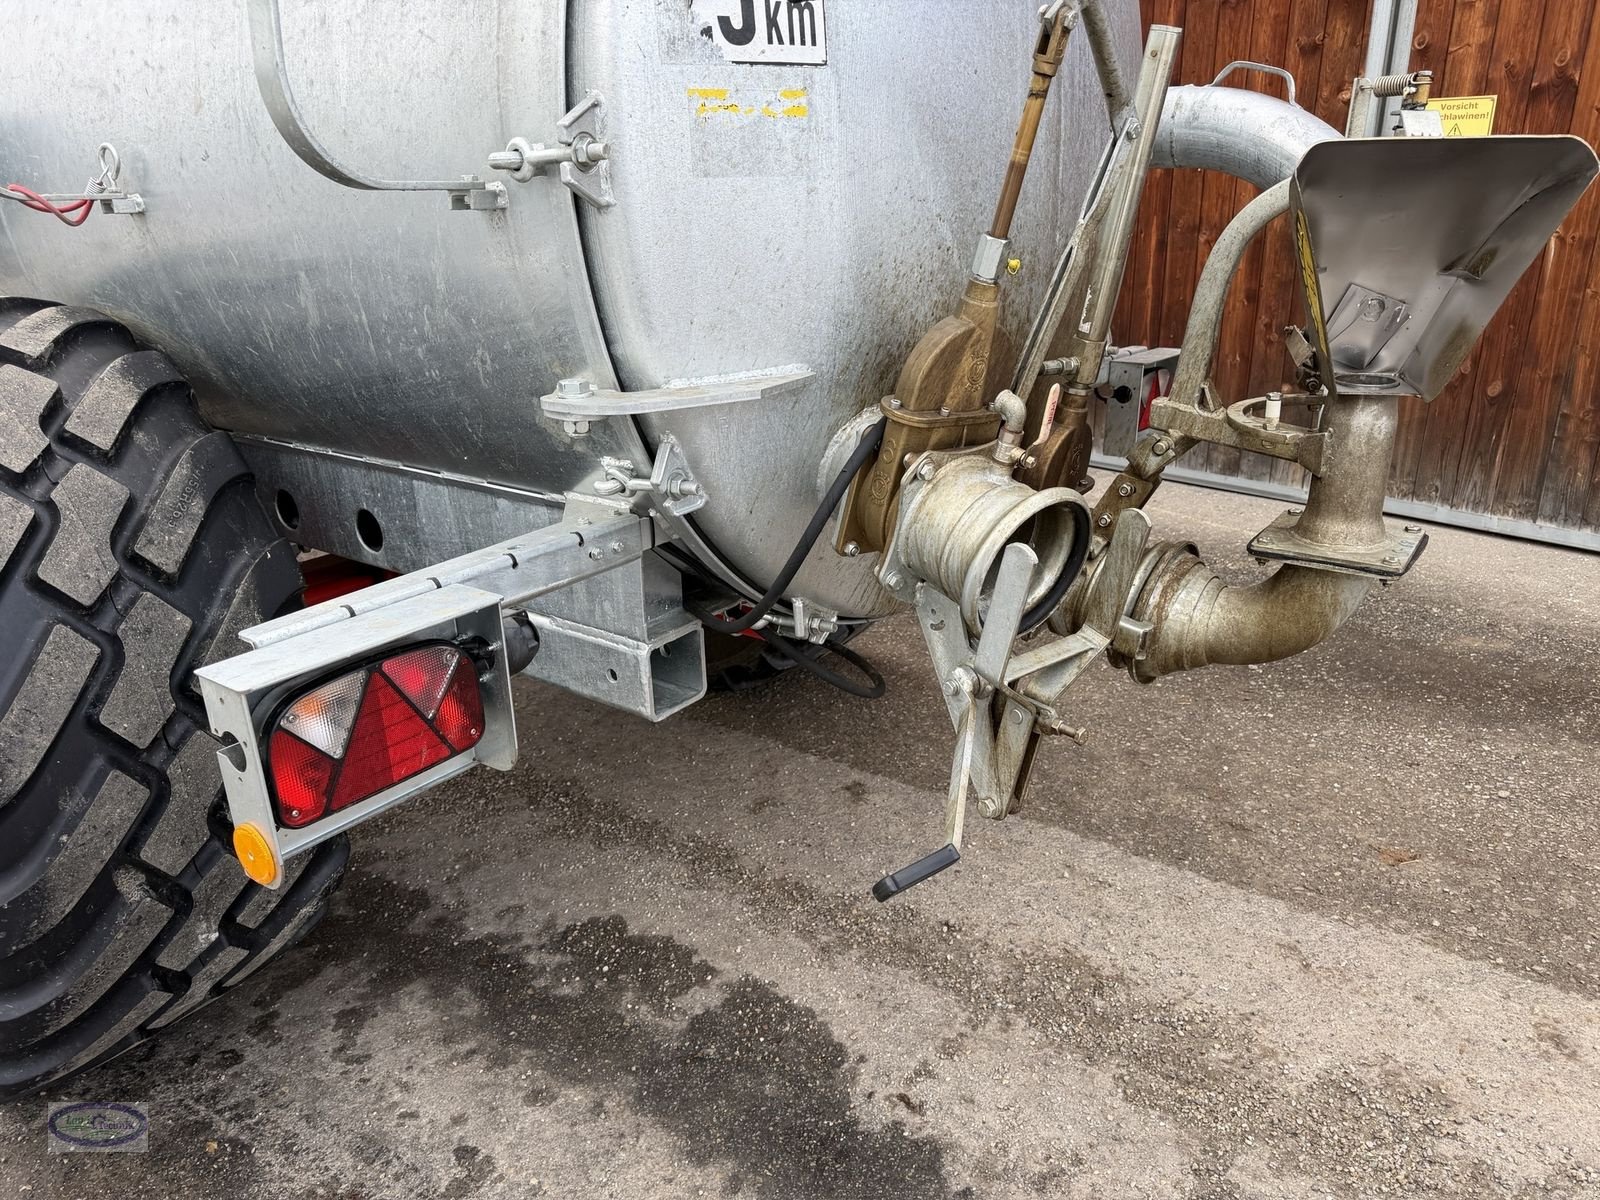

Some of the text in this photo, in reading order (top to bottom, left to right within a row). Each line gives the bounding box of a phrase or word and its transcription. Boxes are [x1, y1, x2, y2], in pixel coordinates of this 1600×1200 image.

[765, 0, 817, 47] km
[1440, 102, 1479, 111] Vorsicht
[1440, 112, 1490, 121] chlawinen!
